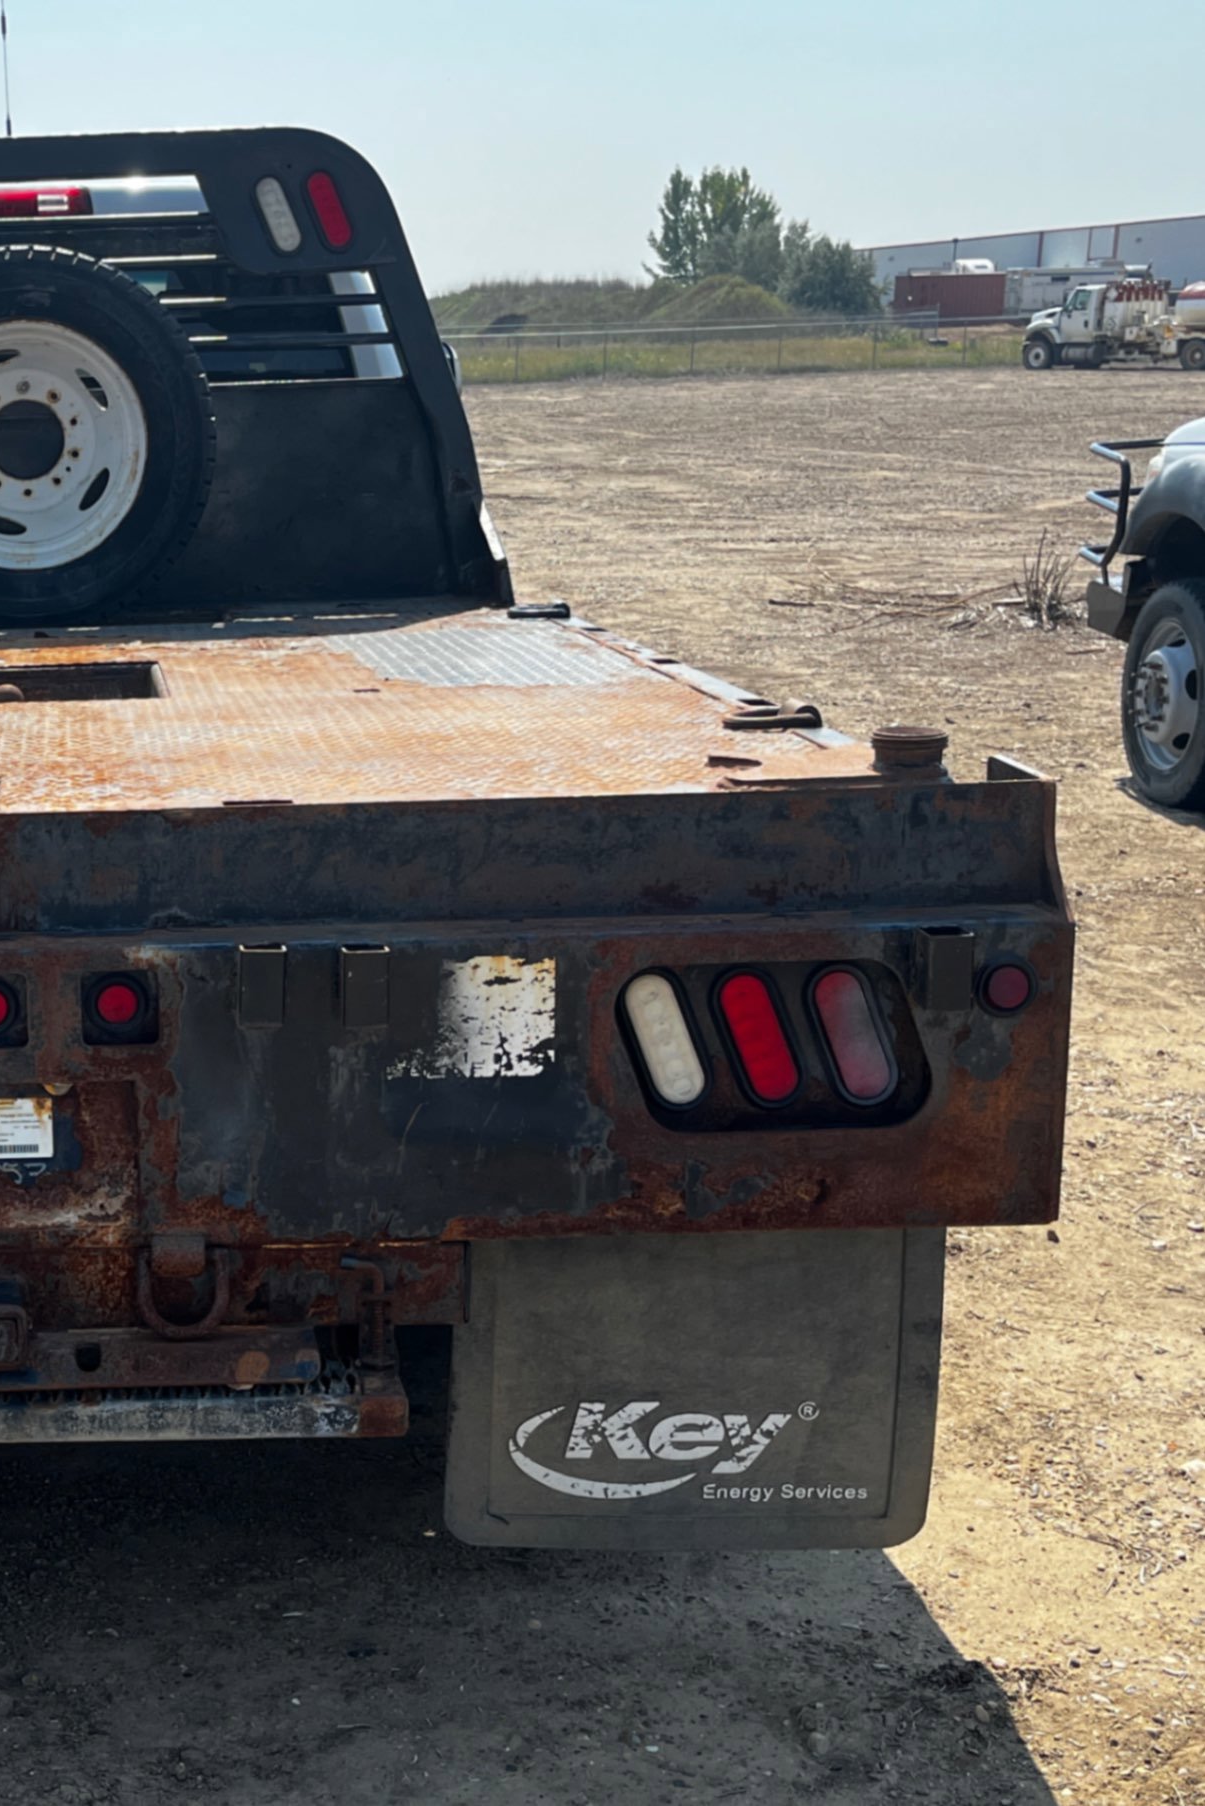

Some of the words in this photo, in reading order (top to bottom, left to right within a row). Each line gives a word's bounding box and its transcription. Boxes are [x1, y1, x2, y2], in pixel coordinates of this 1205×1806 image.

[564, 1401, 792, 1474] Key
[703, 1484, 774, 1502] Energy
[780, 1483, 868, 1500] Services
